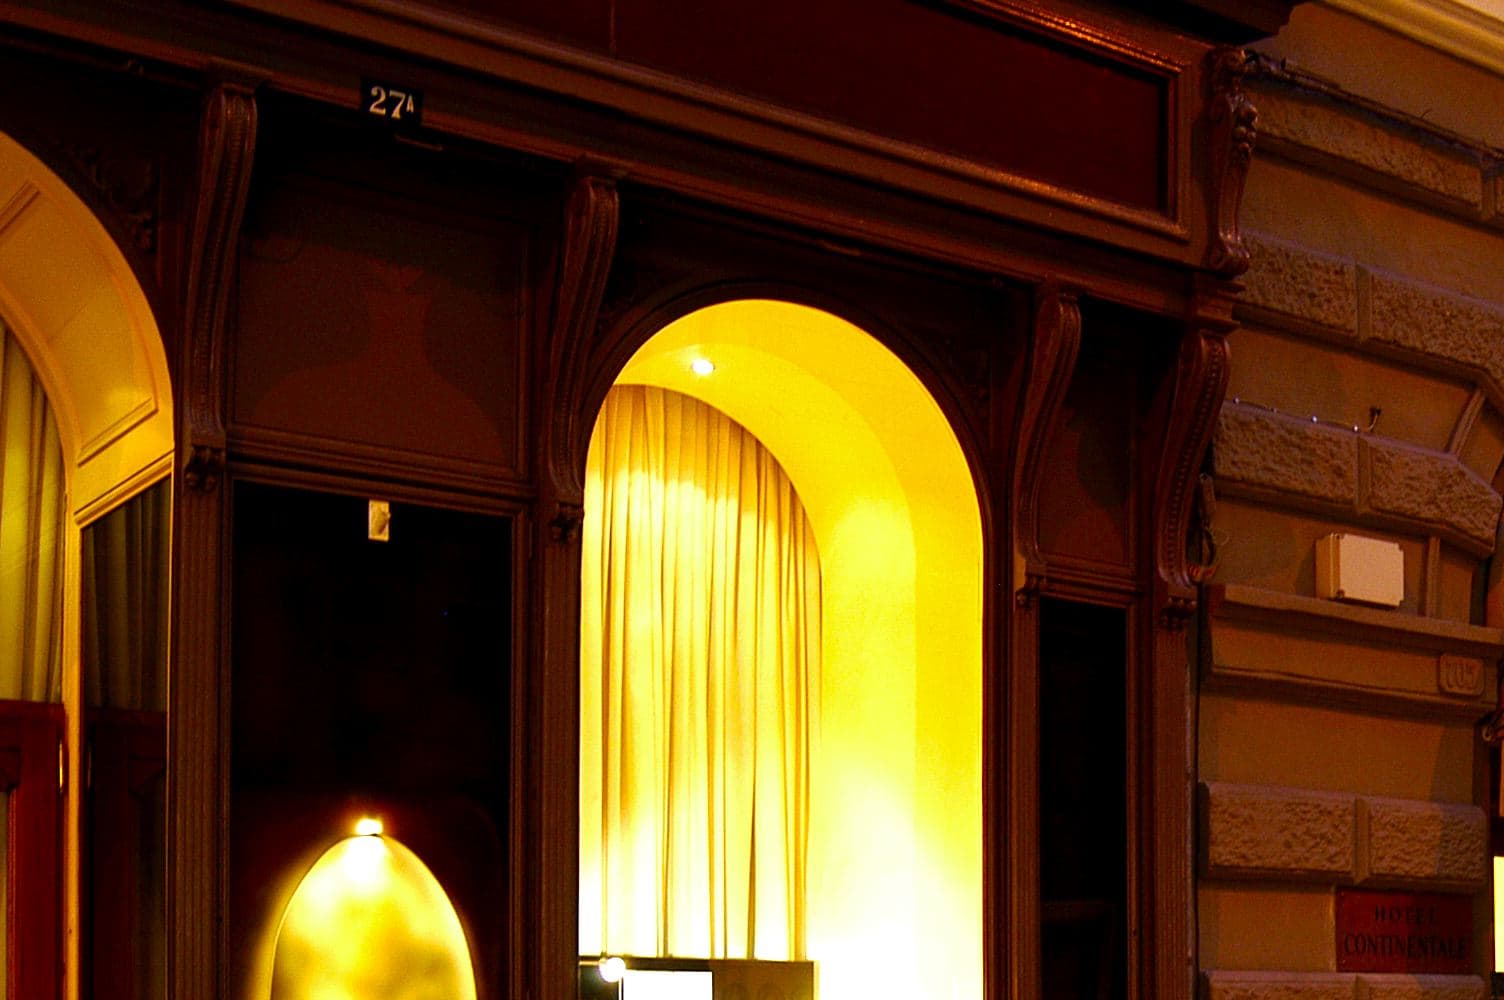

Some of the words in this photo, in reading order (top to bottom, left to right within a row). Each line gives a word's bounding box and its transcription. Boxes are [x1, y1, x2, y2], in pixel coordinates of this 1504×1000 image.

[369, 85, 415, 120] 27A
[1375, 904, 1440, 924] HOTEL
[1343, 933, 1466, 960] CONTINENTALE
